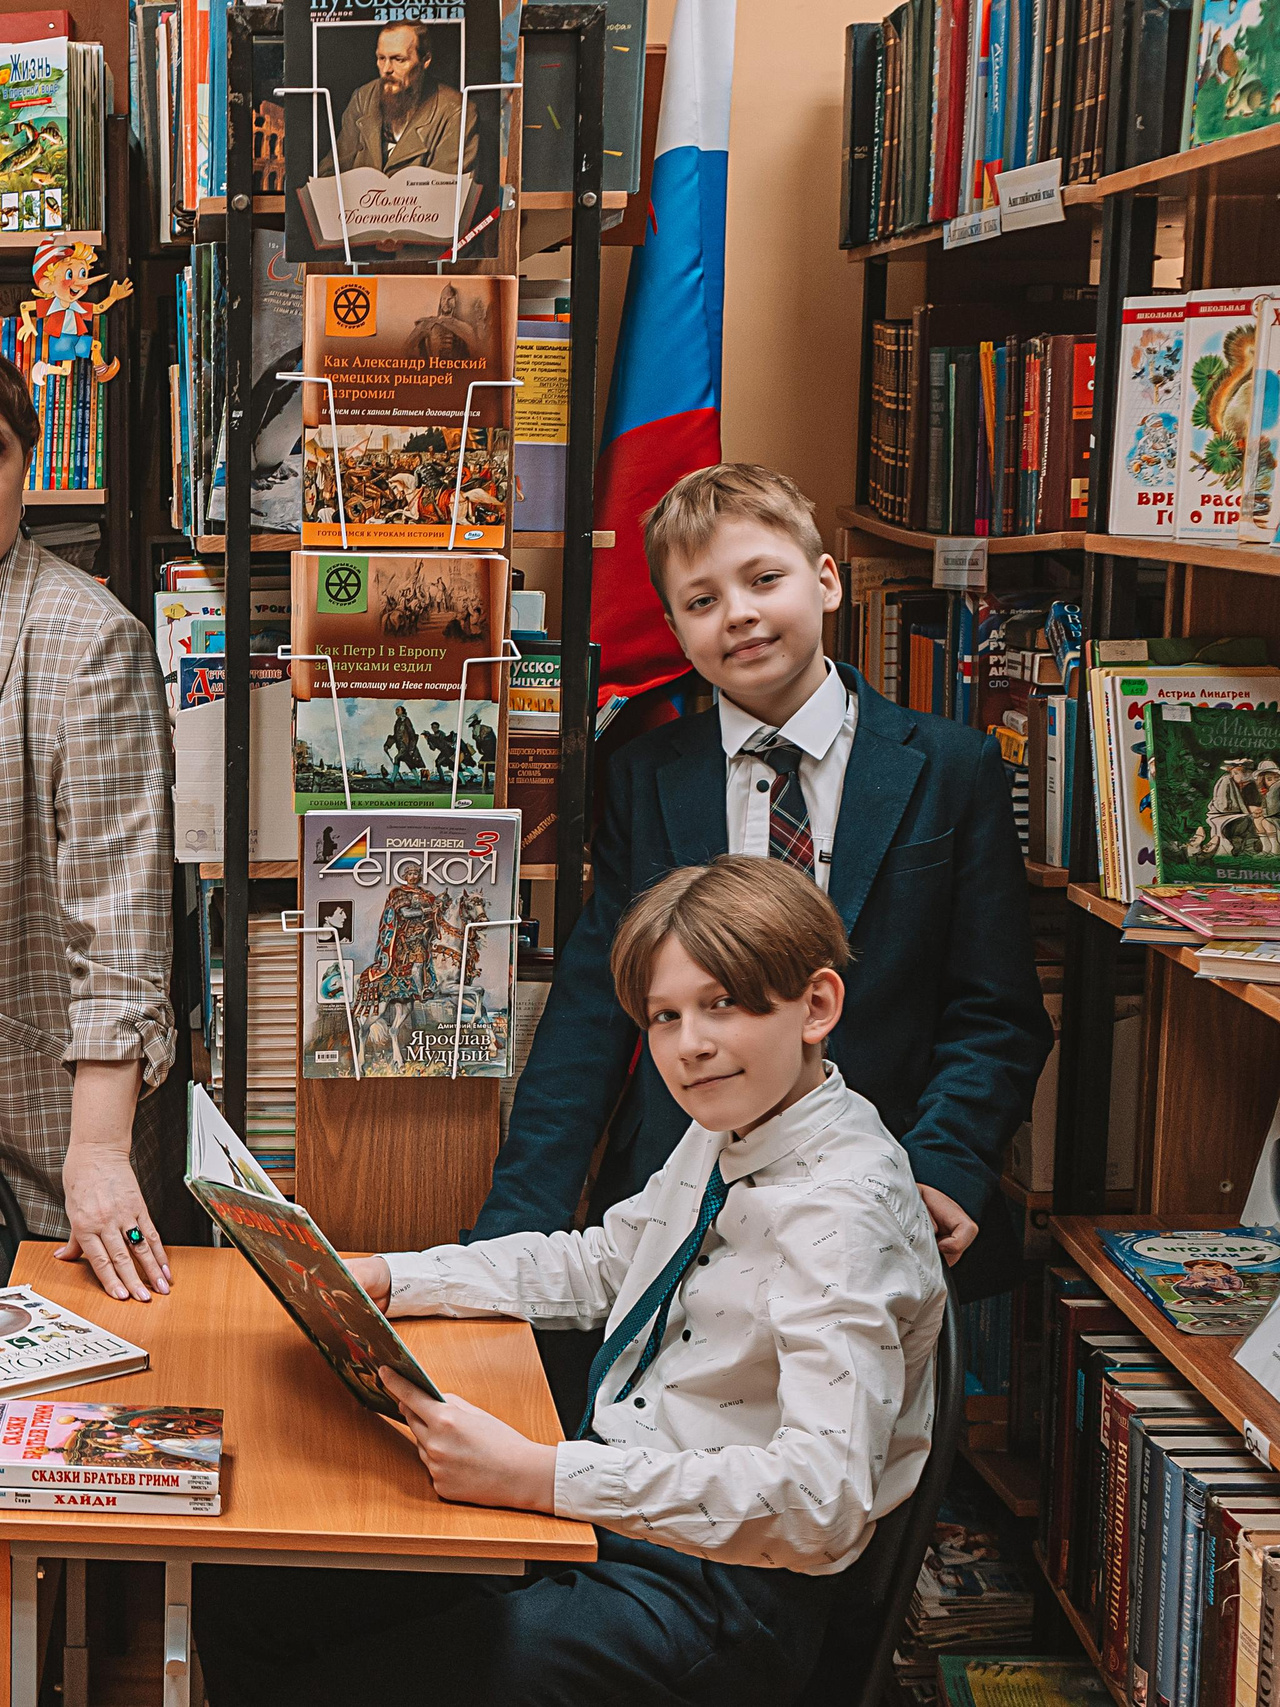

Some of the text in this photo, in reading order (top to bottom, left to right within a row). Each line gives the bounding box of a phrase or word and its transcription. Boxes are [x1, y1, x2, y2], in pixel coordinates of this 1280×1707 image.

[374, 5, 465, 22] звезда
[10, 52, 52, 83] Жизнь
[359, 189, 419, 208] Помни
[337, 208, 440, 227] Достоевского
[333, 283, 371, 296] ОТКРЫВАЕМ
[1136, 310, 1184, 321] ШКОЛЬНАЯ
[1199, 303, 1246, 314] ШКОЛЬНАЯ
[324, 355, 487, 372] Как Александр Невский
[323, 372, 453, 390] немецких рыцарей
[323, 388, 396, 404] разгромил
[374, 530, 405, 539] УРОКАМ
[407, 530, 445, 539] ИСТОРИИ
[314, 644, 340, 657] Как
[343, 644, 376, 660] Петр
[388, 648, 395, 657] в
[398, 644, 448, 661] Европу
[314, 662, 329, 672] за
[393, 661, 433, 673] ездил
[321, 682, 349, 693] ноую
[350, 681, 388, 692] столицу
[389, 682, 400, 690] на
[401, 681, 423, 690] Неве
[1158, 688, 1250, 701] Астрид Линдгрен
[309, 799, 355, 808] ГОТОВИМЯ
[364, 799, 396, 808] УРОКАМ
[398, 800, 435, 808] ИСТОРИИ
[385, 838, 465, 849] РОМАН-ГАЗЕТА
[469, 831, 500, 858] 3
[1216, 867, 1280, 881] ВЕЛИКИ
[437, 1022, 471, 1031] Дмитий
[409, 1030, 492, 1052] Ярослав
[406, 1045, 491, 1067] Мудрый
[812, 1230, 838, 1247] GENIUS
[1163, 1246, 1202, 1254] ЧТО
[14, 1336, 32, 1349] 5
[828, 1369, 851, 1387] GENIUS
[719, 1398, 744, 1409] GENIUS
[1, 1416, 28, 1446] СКАЗКИ
[22, 1403, 56, 1461] БРАТЬЕВ ГРИММ
[820, 1428, 847, 1437] GENIUS
[31, 1468, 81, 1484] СКАЗКИ
[84, 1471, 136, 1486] БРАТЬЕВ
[138, 1473, 180, 1488] ГРИММ
[568, 1463, 595, 1480] GENIUS
[1143, 1447, 1153, 1495] ДЕТЕЙ
[53, 1493, 118, 1507] ХАЙДИ
[798, 1483, 824, 1506] GENIUS
[756, 1492, 777, 1516] GENIUS
[697, 1502, 717, 1527] GENIUS
[1109, 1440, 1130, 1632] ЭНЦИКЛОПЕДИЯ
[1156, 1471, 1173, 1681] ЭНЦИКЛОПЕДИЯ ДЛЯ ДЕТЕЙ
